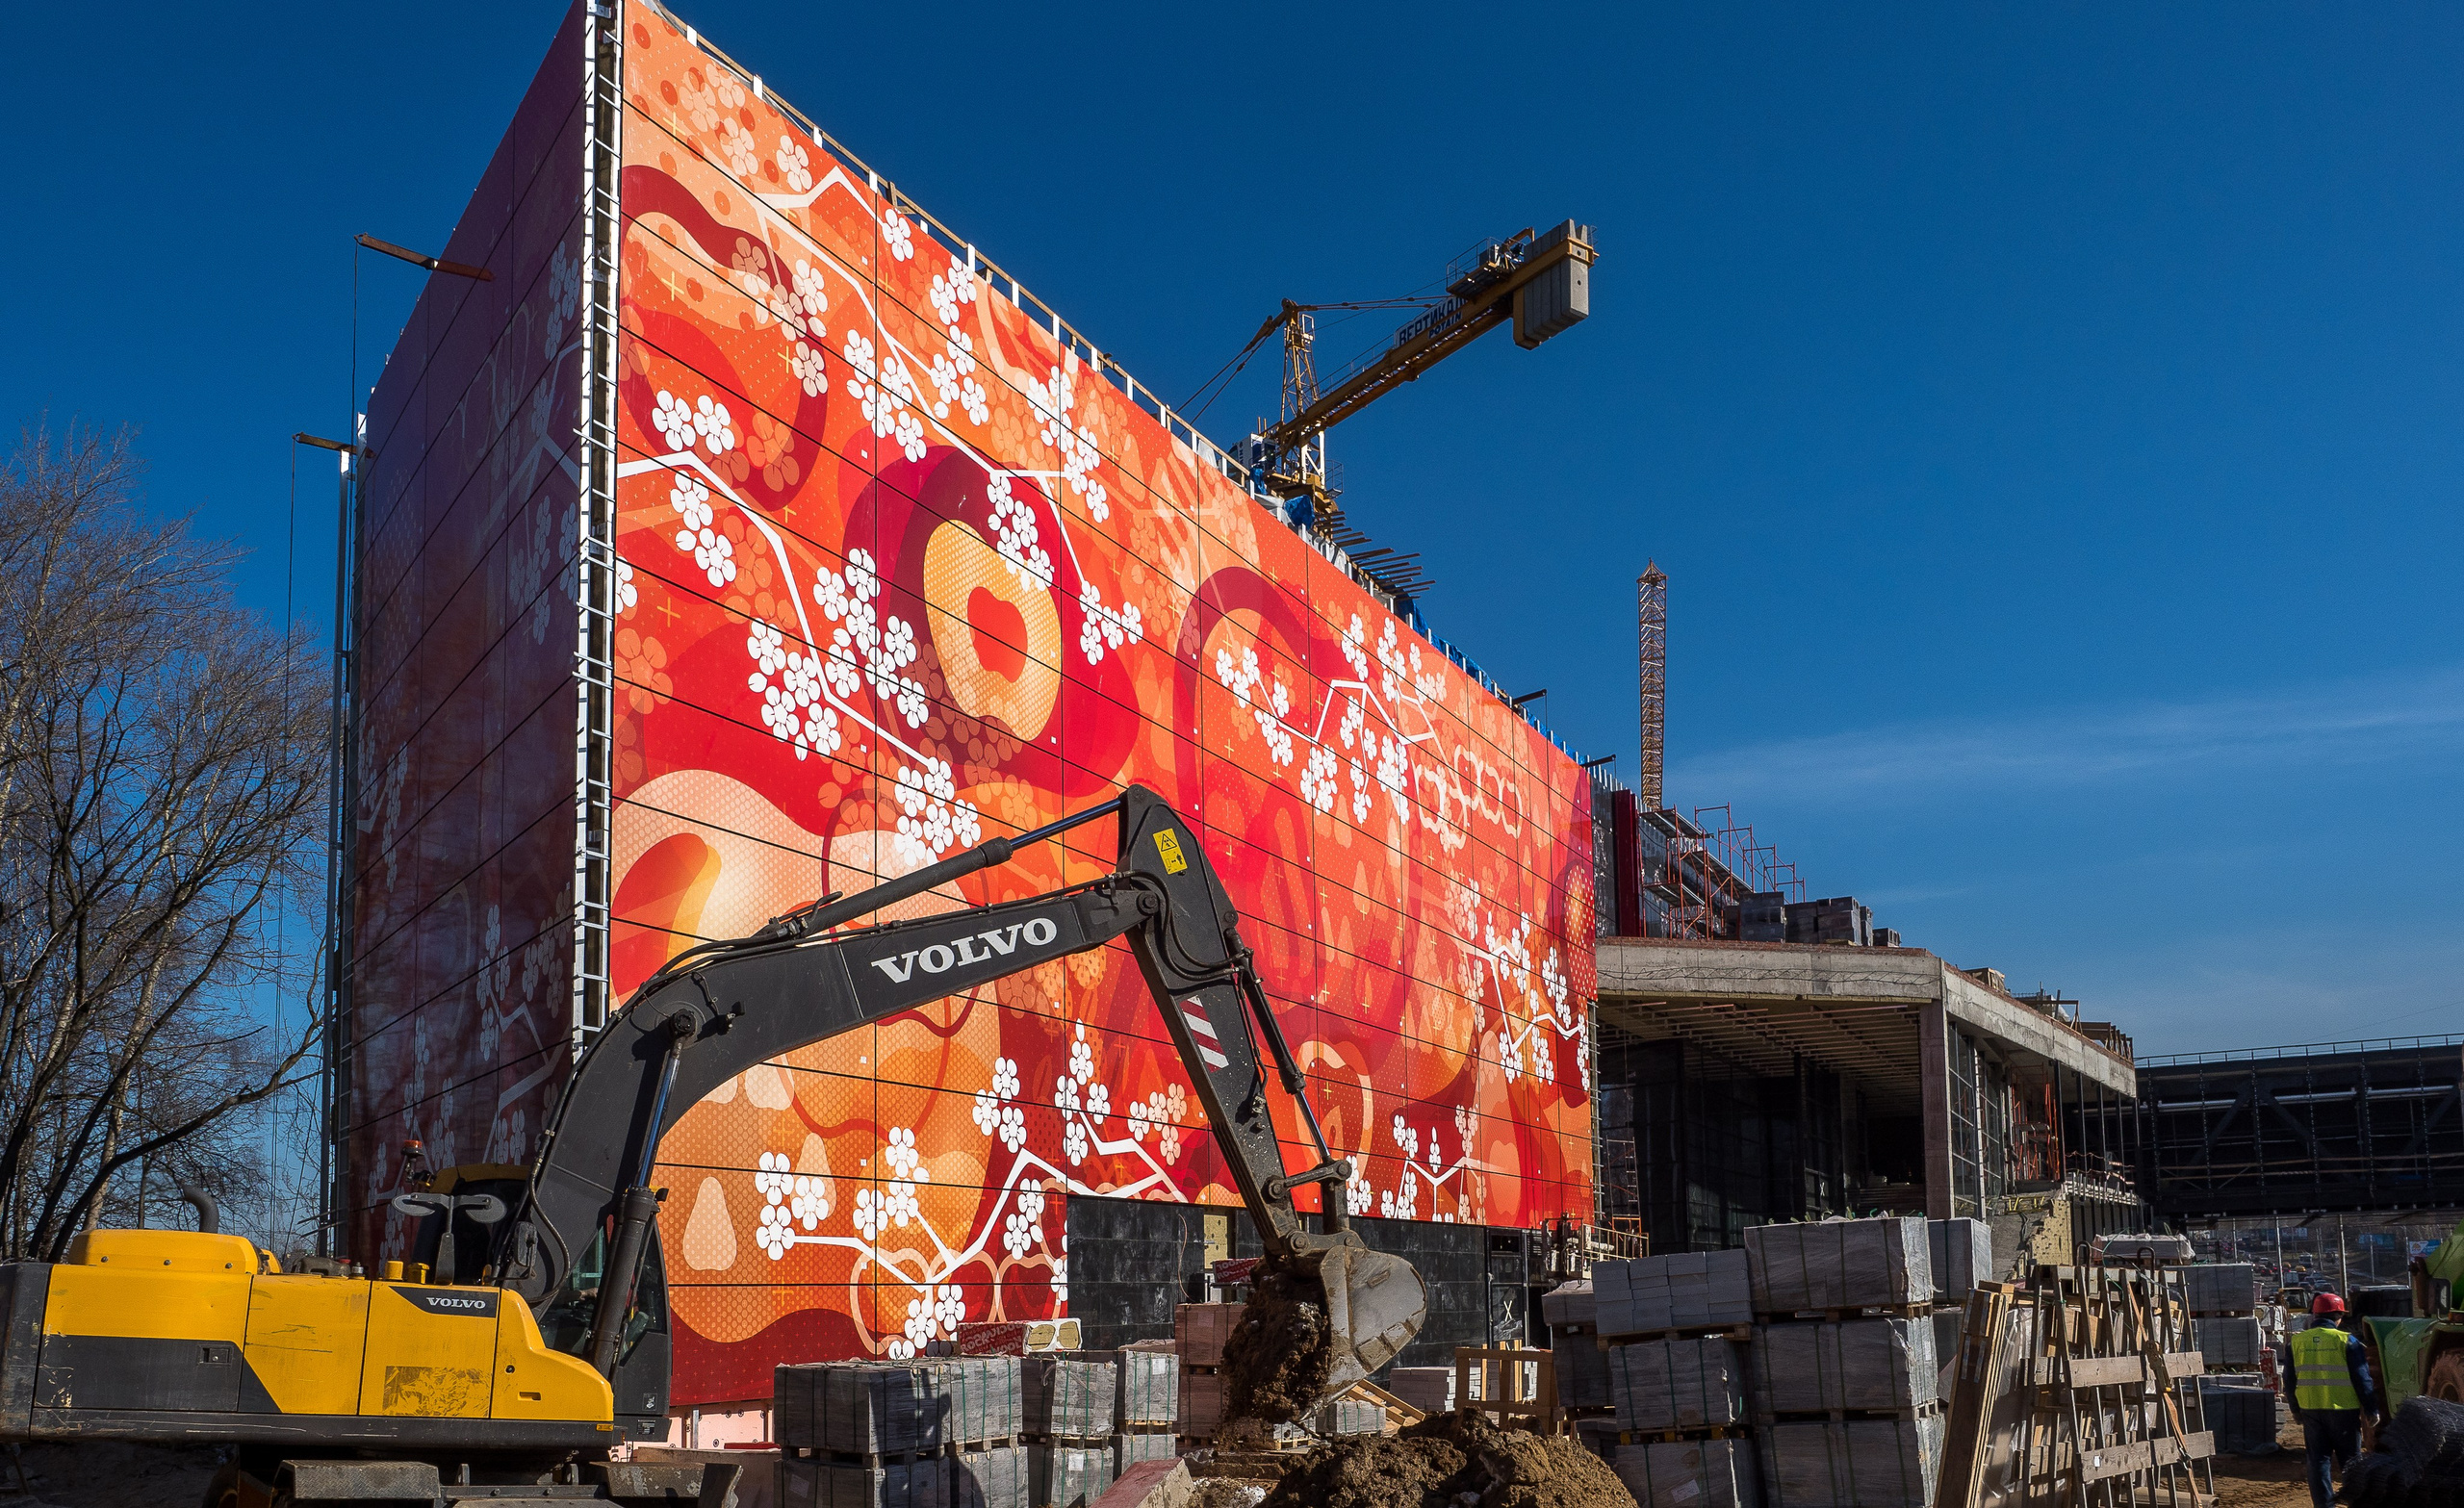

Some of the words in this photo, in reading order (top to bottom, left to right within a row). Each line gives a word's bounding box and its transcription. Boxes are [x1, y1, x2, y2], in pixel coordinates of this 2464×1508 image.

[1428, 311, 1462, 339] POTAIN
[871, 917, 1058, 984] VOLVO
[426, 1297, 486, 1309] VOLVO
